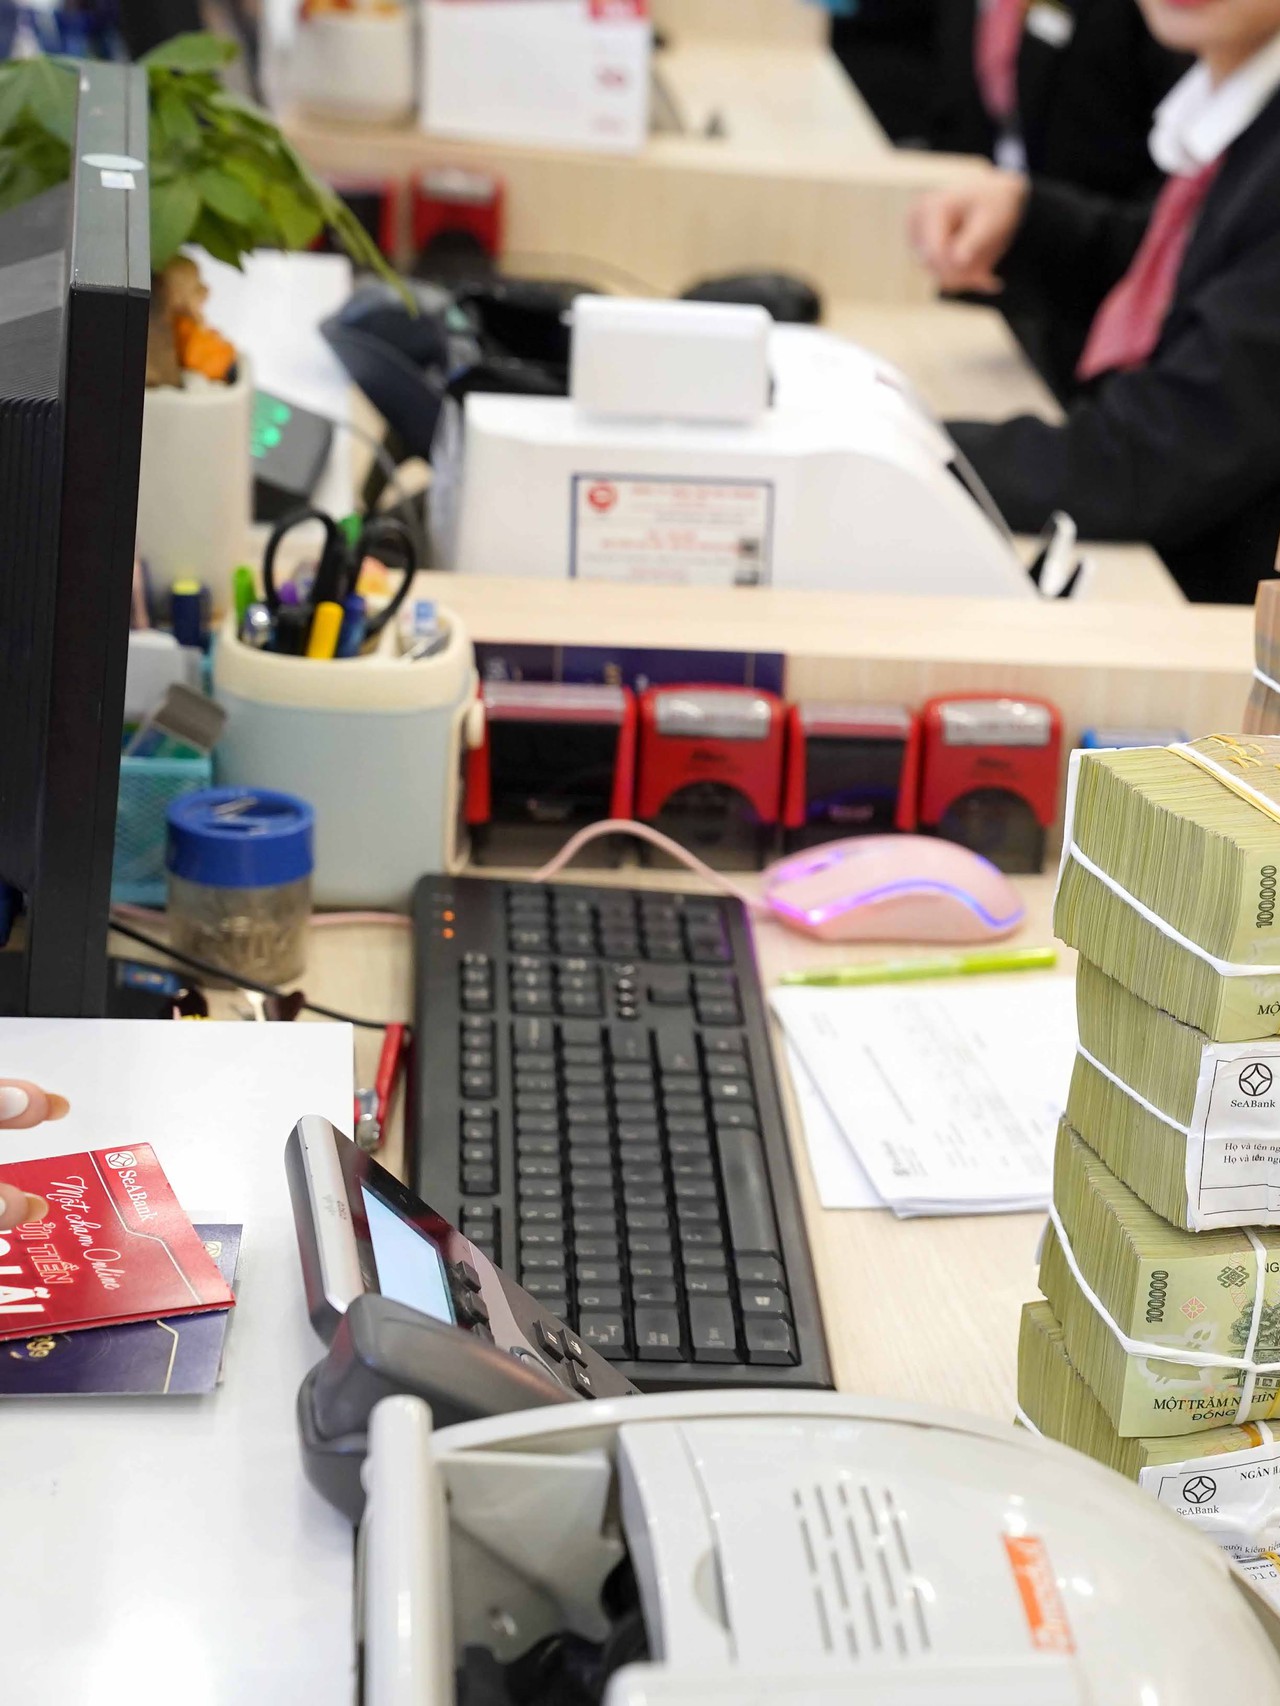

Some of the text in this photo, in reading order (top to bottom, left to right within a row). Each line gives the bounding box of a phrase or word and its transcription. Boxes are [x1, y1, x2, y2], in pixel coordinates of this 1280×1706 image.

[1256, 865, 1277, 928] 100.000
[1230, 1099, 1276, 1108] SeABank
[1225, 1142, 1238, 1151] Họ
[1241, 1142, 1250, 1150] và
[1254, 1142, 1267, 1151] tên
[1223, 1155, 1237, 1163] Họ
[1239, 1154, 1249, 1163] và
[1251, 1153, 1265, 1162] tên
[118, 1169, 154, 1221] SeABank
[16, 1219, 57, 1241] ỬI
[46, 1176, 126, 1290] Một chạm Online
[1146, 1270, 1168, 1323] 100.000
[1153, 1391, 1278, 1413] MỘT TRĂM NHÌN
[1192, 1408, 1236, 1421] ĐỒNG
[1240, 1467, 1270, 1481] NGÂN
[1176, 1504, 1220, 1516] SeABank
[1245, 1540, 1266, 1553] kiểm
